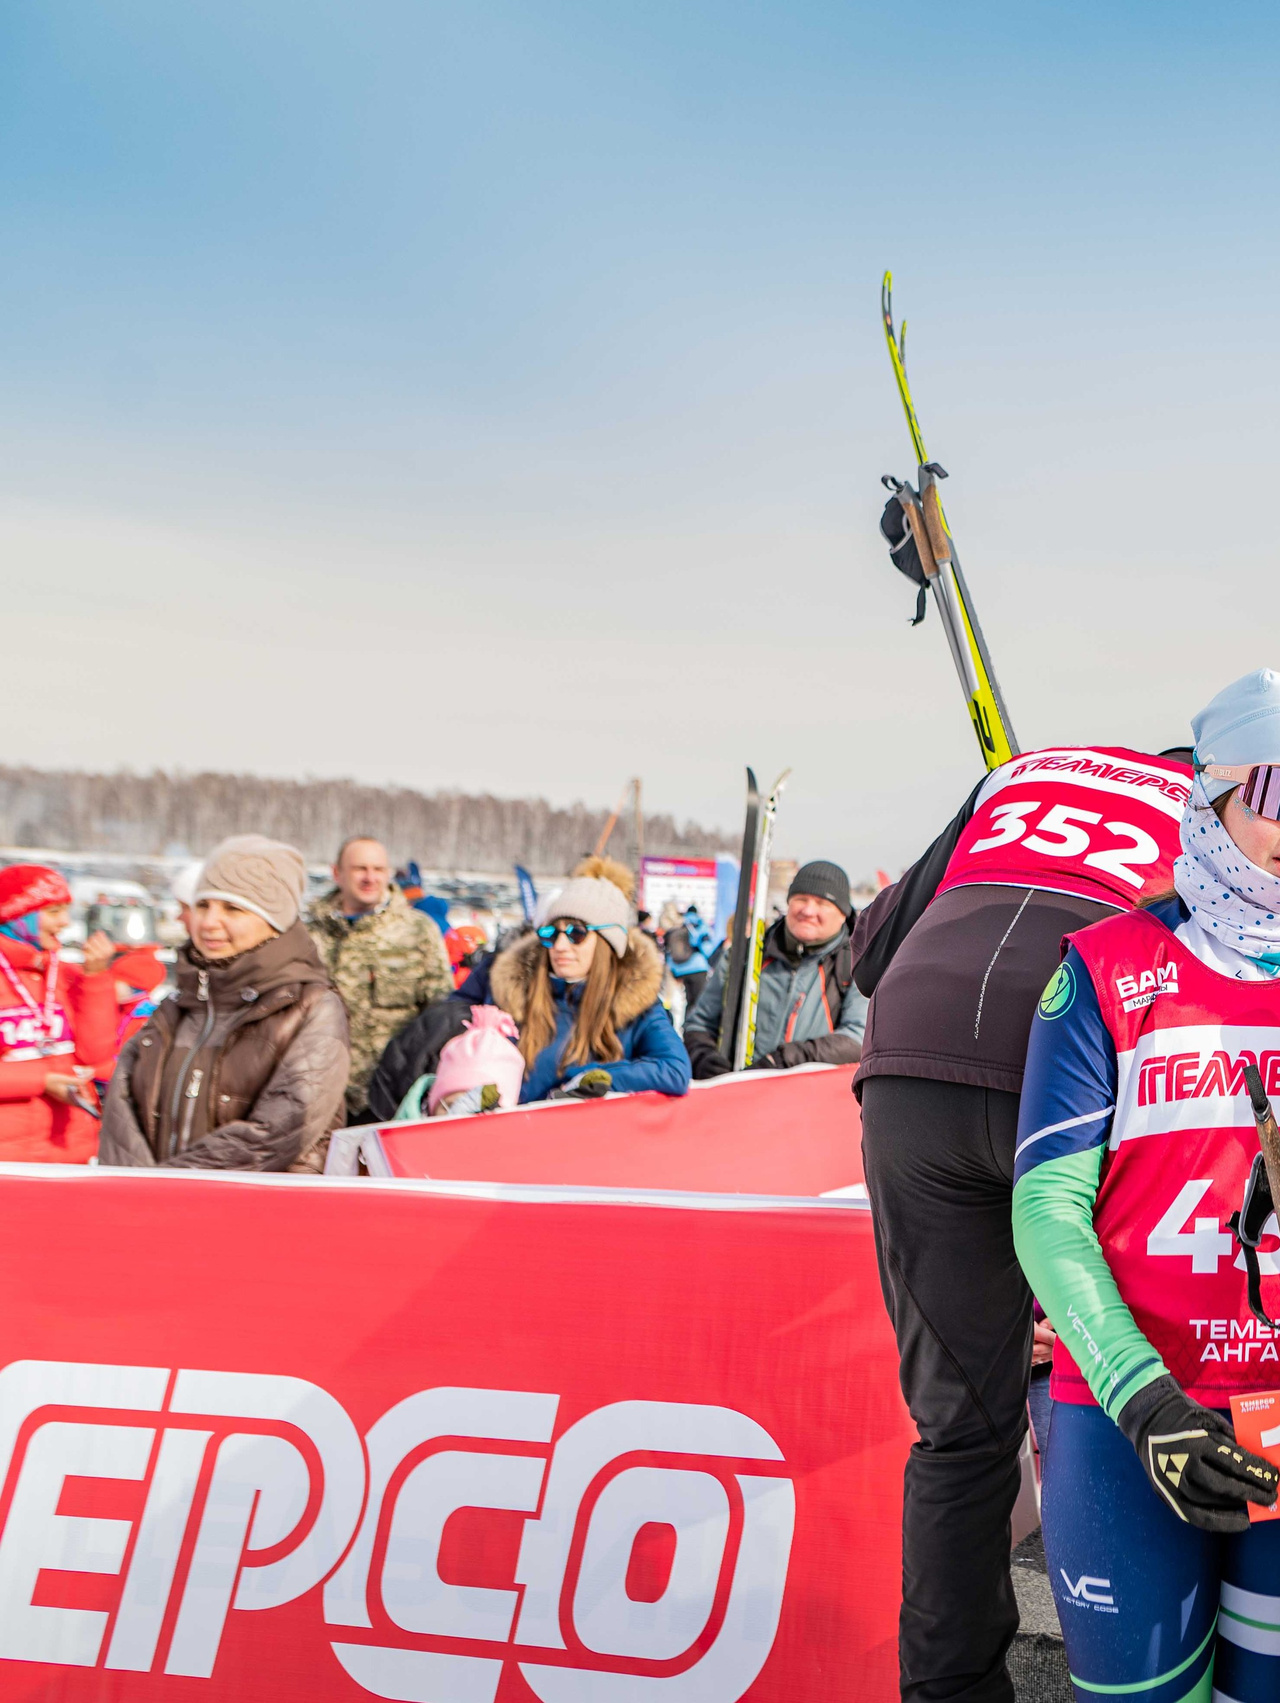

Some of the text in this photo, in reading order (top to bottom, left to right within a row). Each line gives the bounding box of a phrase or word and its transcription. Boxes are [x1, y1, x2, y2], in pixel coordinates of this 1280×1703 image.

[968, 801, 1160, 890] 352
[1115, 961, 1178, 999] БАМ
[1066, 1304, 1109, 1368] VICTORY
